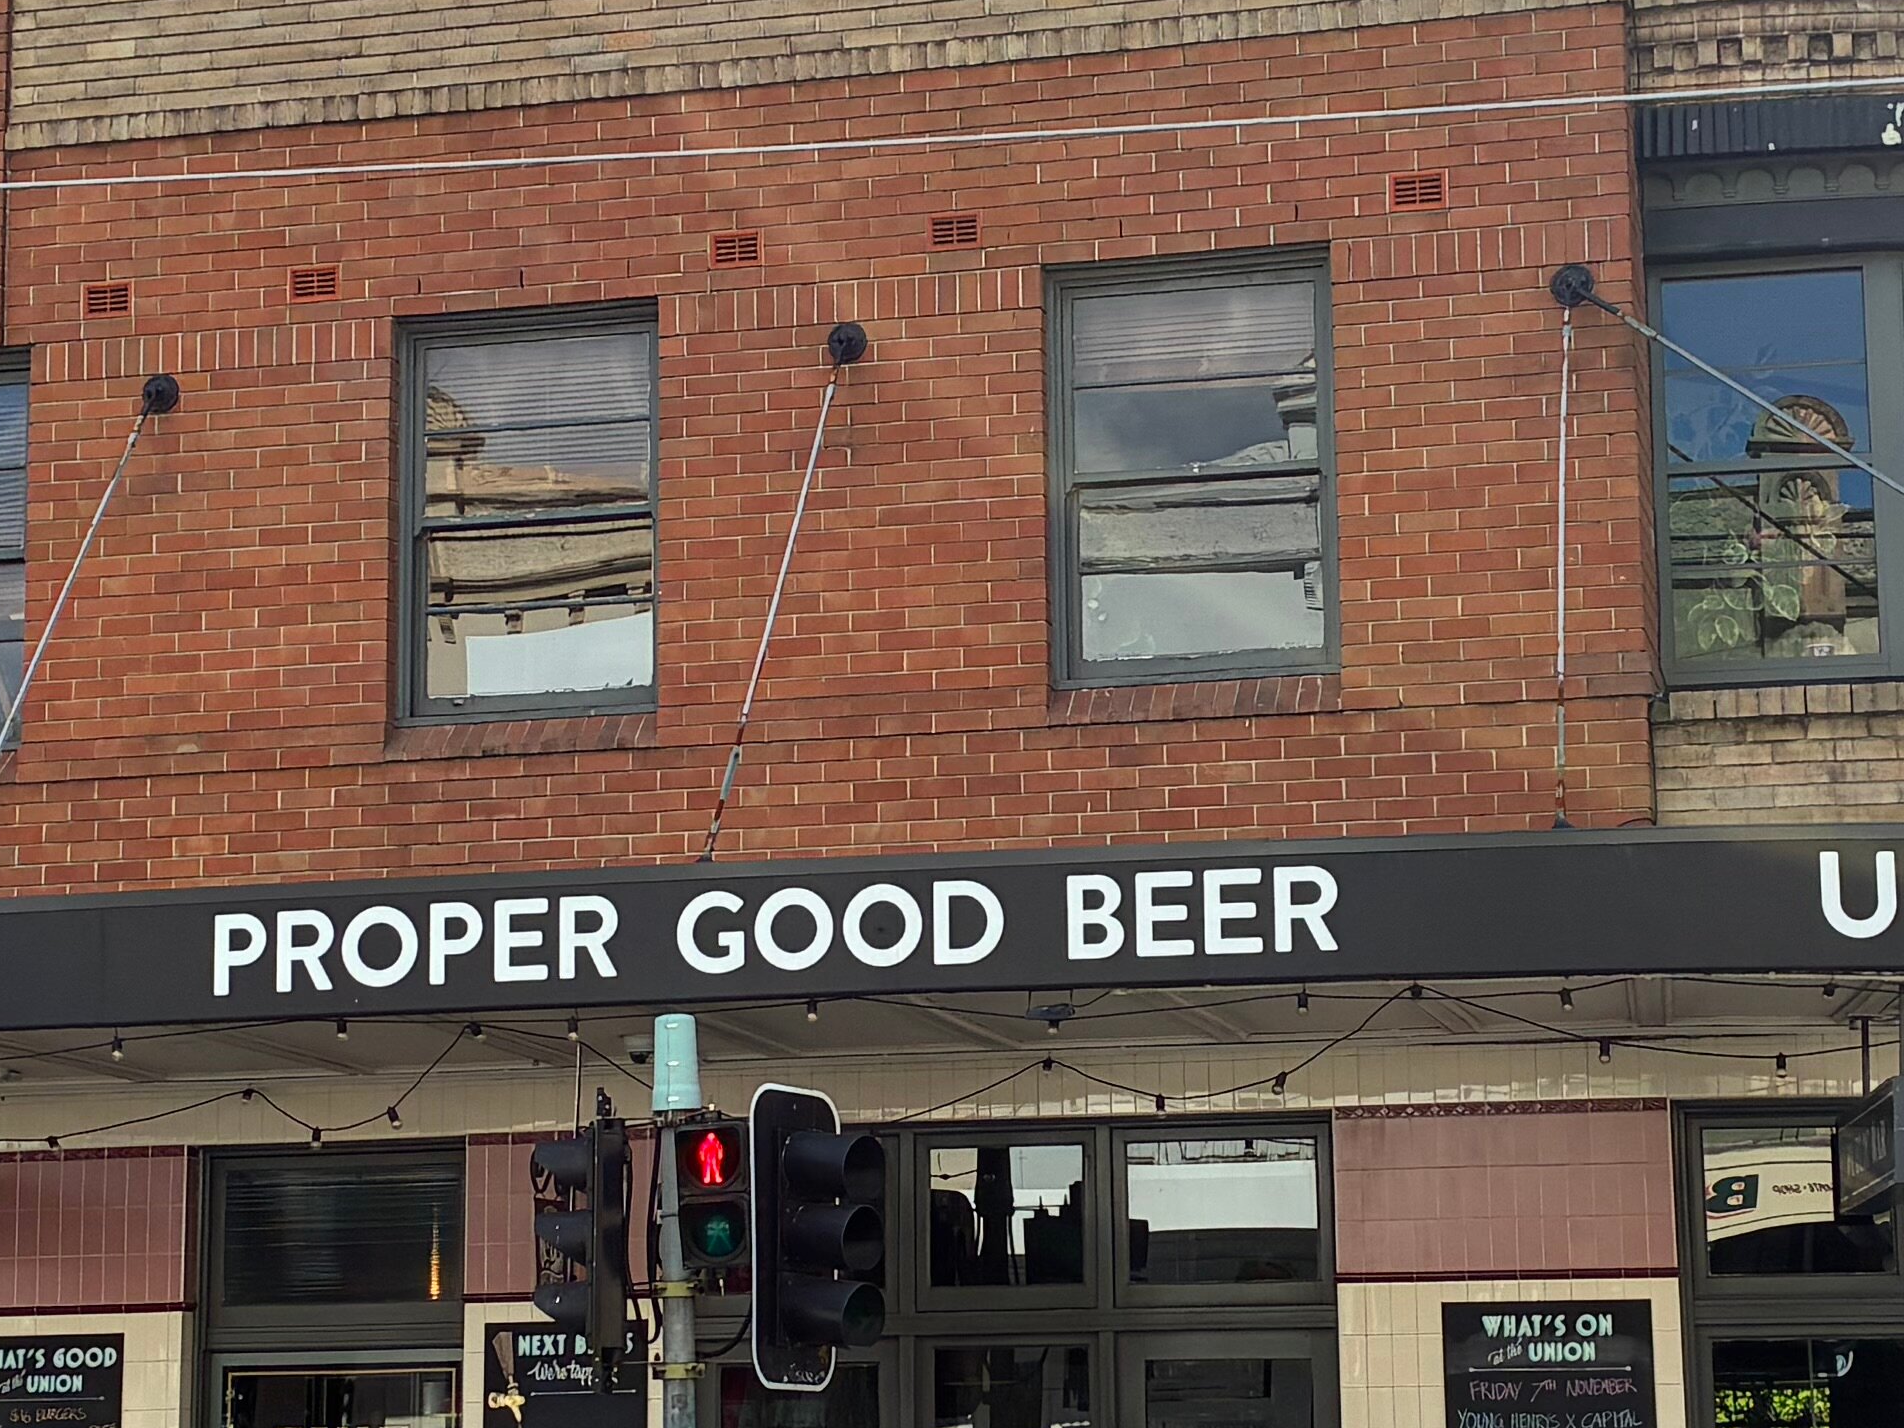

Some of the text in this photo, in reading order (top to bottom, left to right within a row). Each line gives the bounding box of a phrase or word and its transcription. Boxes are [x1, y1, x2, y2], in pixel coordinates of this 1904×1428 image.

[214, 866, 1337, 995] PROPER GOOD BEER
[1481, 1313, 1613, 1337] WHAT'S ON
[518, 1334, 567, 1356] NEXT
[1528, 1341, 1596, 1363] UNION
[53, 1347, 117, 1368] GOOD
[26, 1374, 83, 1393] UNION
[1469, 1379, 1522, 1401] FRIDAY
[1566, 1377, 1637, 1397] NOVEMBER
[1581, 1408, 1643, 1428] CAPITAL
